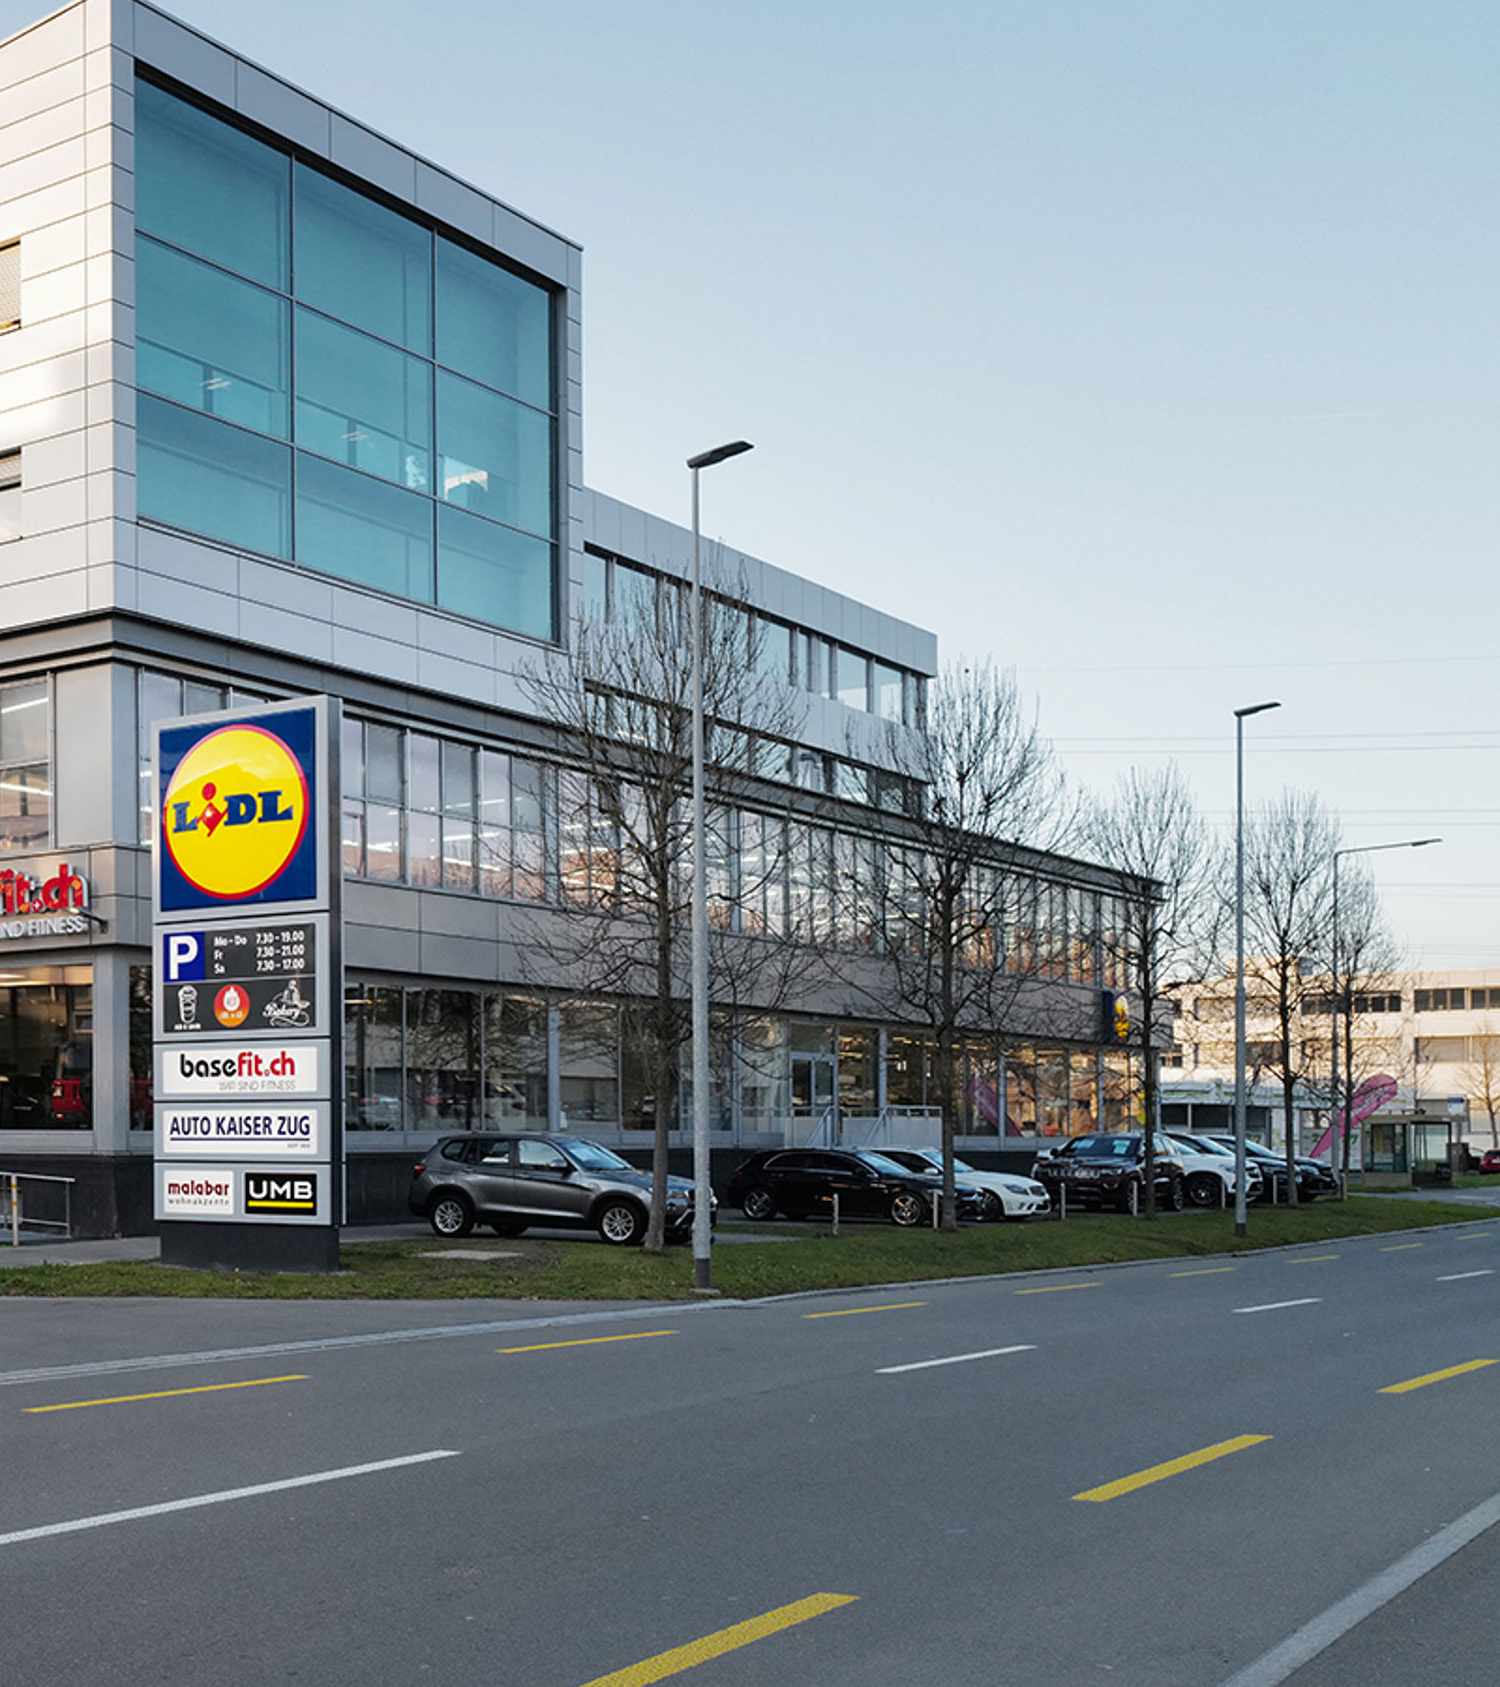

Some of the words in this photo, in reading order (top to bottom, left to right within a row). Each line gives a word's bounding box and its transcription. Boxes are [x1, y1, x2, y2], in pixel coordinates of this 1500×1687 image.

[169, 935, 198, 980] P
[180, 1050, 295, 1078] basefit.ch
[170, 1116, 211, 1135] AUTO
[216, 1116, 272, 1135] KAISER
[277, 1116, 310, 1135] ZUG
[168, 1180, 229, 1196] malabar
[249, 1181, 313, 1199] UMB
